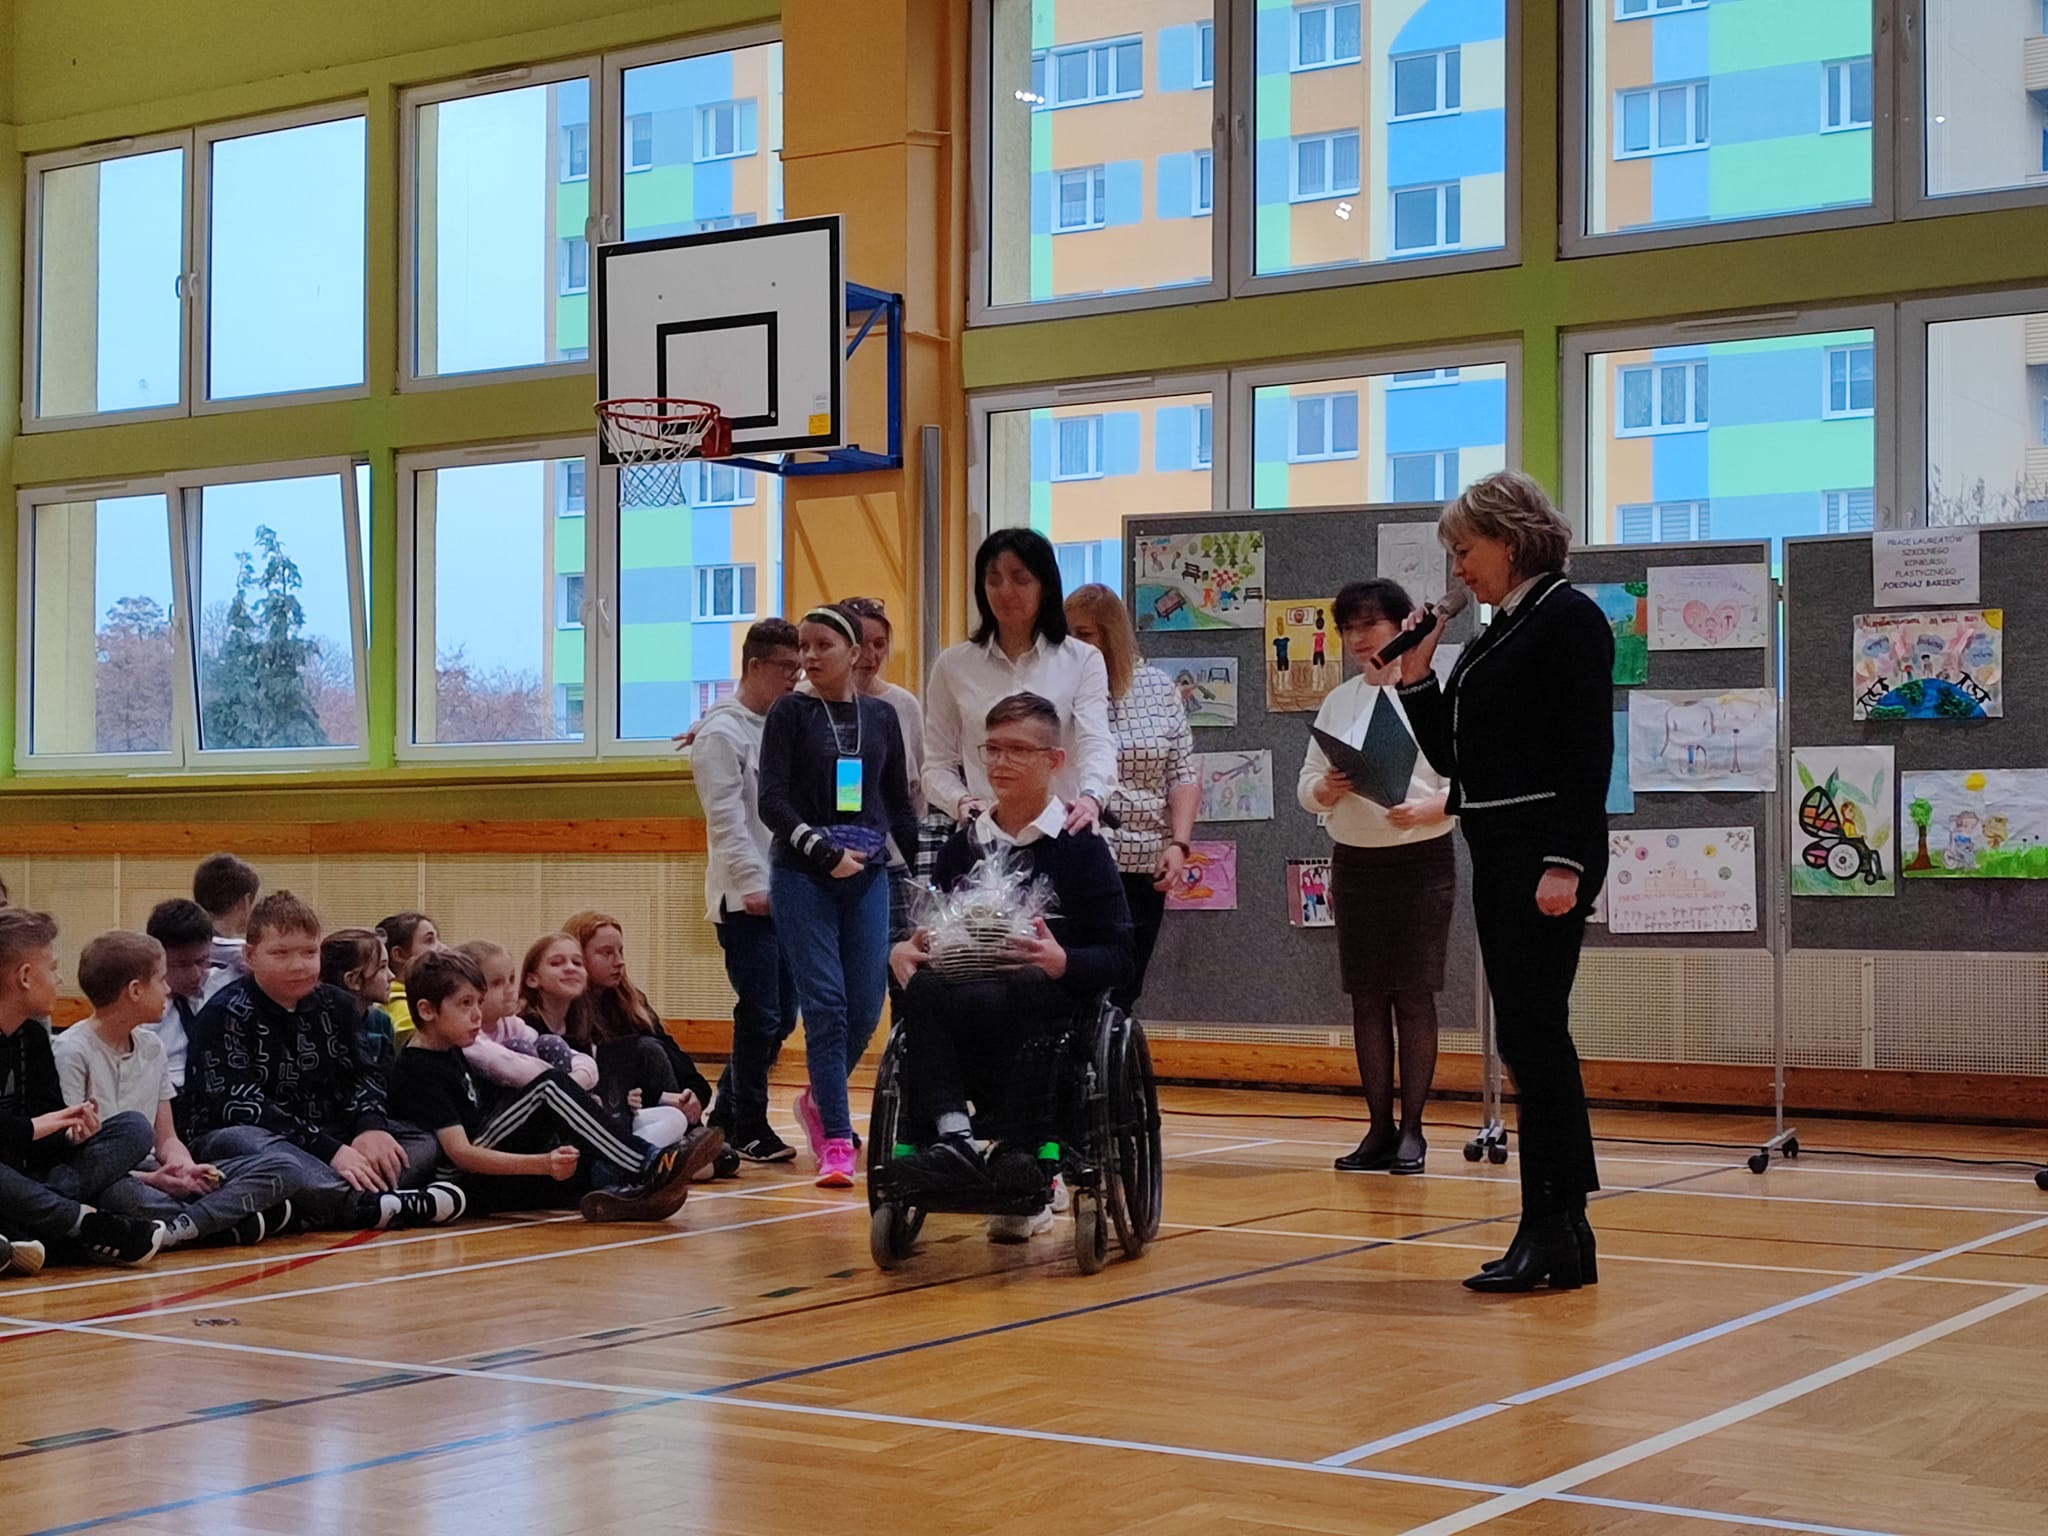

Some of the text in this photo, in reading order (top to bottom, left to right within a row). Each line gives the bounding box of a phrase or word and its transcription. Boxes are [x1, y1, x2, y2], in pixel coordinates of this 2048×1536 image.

[1913, 534, 1963, 546] LAUREATÓW
[1902, 546, 1950, 556] SZKOLNEGO
[1904, 558, 1948, 567] KONKURSU
[1895, 567, 1957, 577] PLASTYCZNEGO
